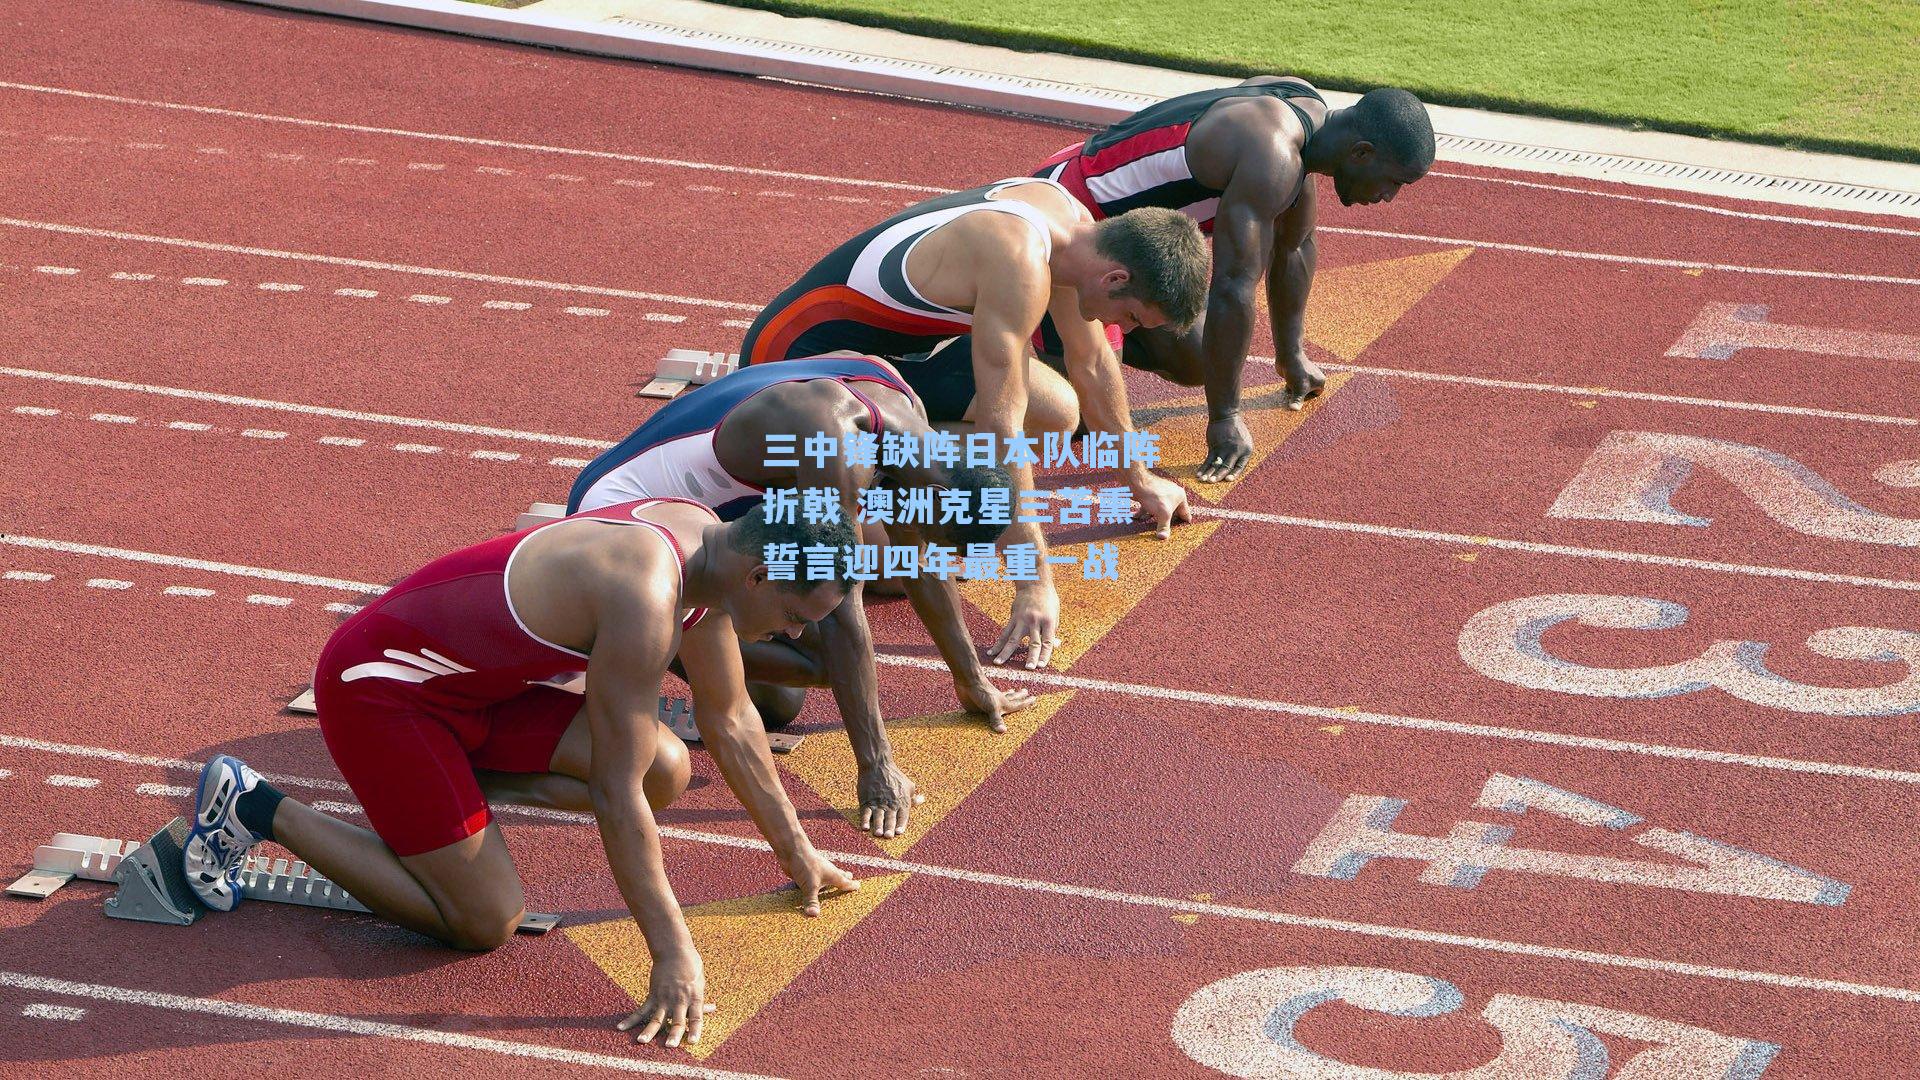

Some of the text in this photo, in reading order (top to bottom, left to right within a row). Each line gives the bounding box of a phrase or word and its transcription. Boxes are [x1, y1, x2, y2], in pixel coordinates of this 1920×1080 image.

[1547, 429, 1920, 547] 2
[1458, 592, 1920, 716] 3
[1291, 772, 1853, 907] 4
[1171, 965, 1783, 1080] 5
